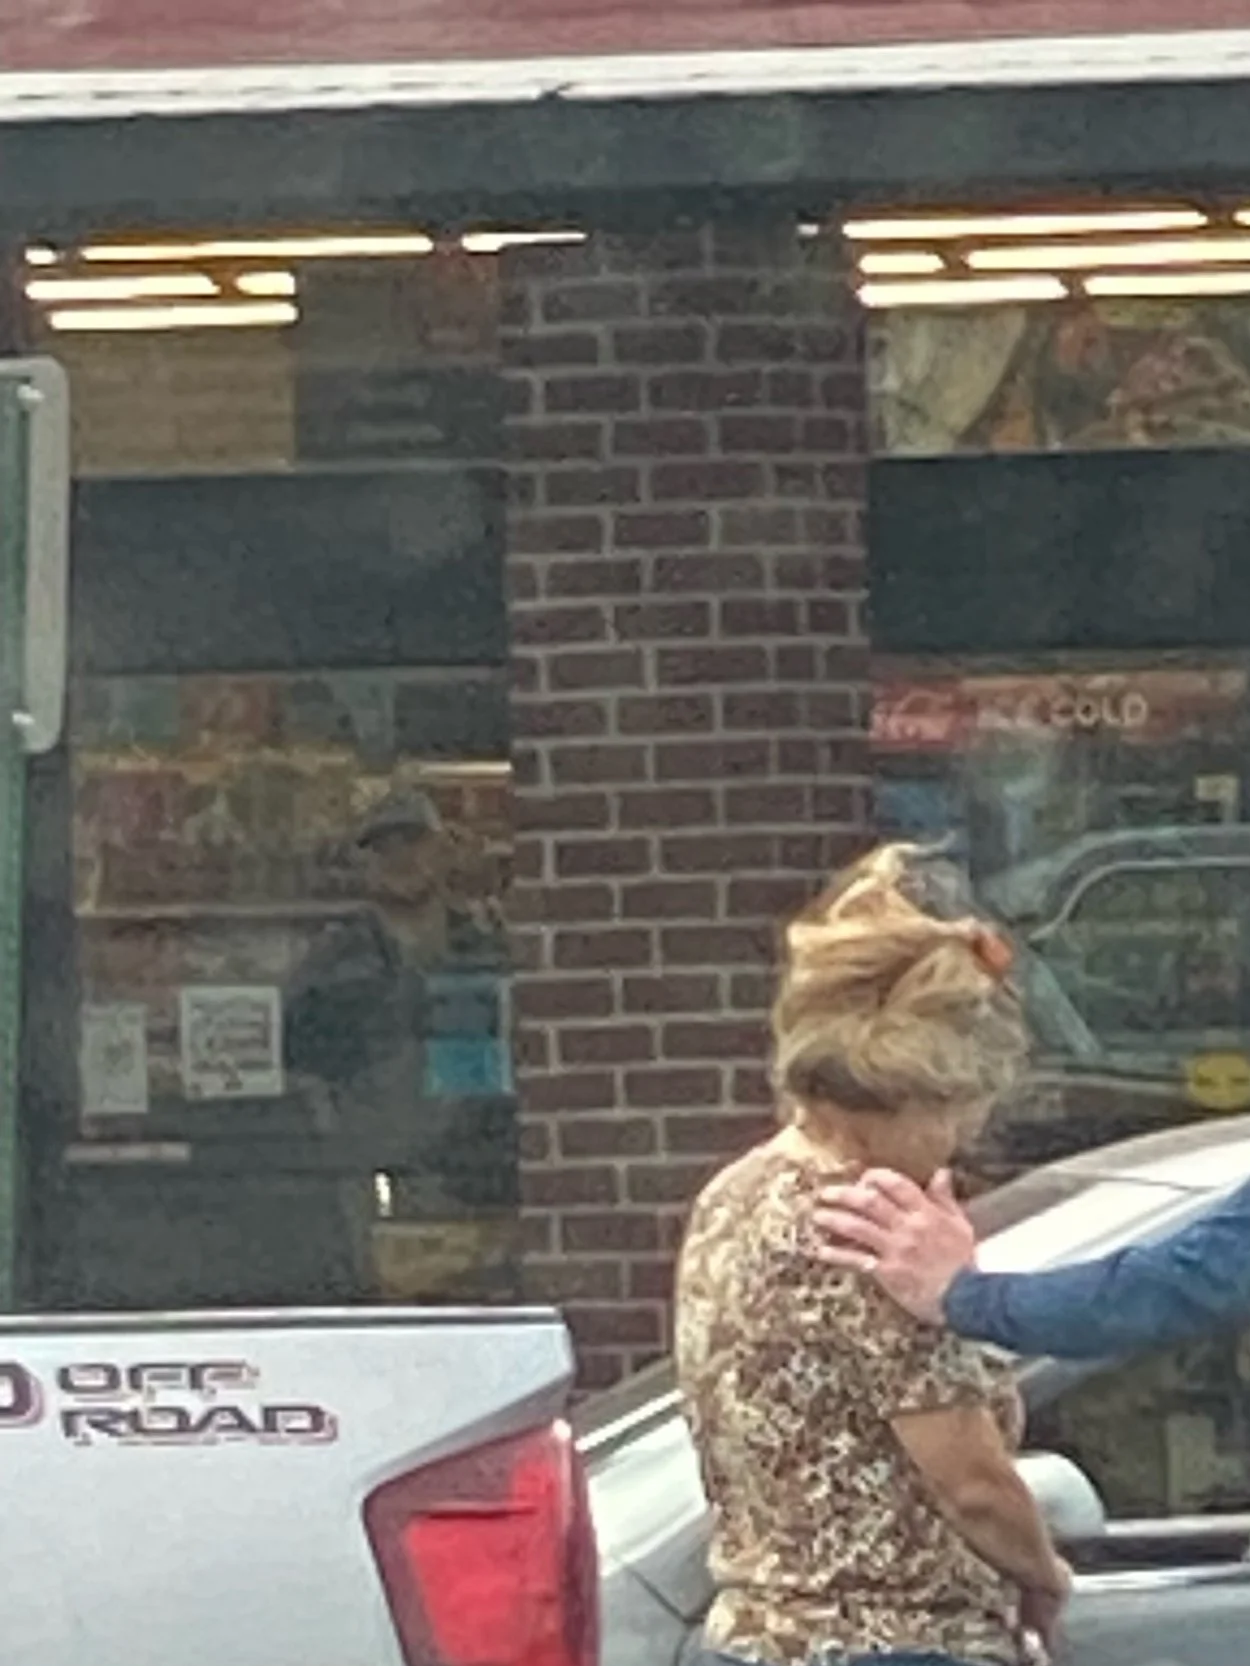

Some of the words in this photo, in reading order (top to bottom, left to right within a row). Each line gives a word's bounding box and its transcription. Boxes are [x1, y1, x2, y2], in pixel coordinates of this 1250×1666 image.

[1051, 691, 1147, 729] COLD
[58, 1361, 258, 1401] OFF
[60, 1404, 338, 1446] ROAD
